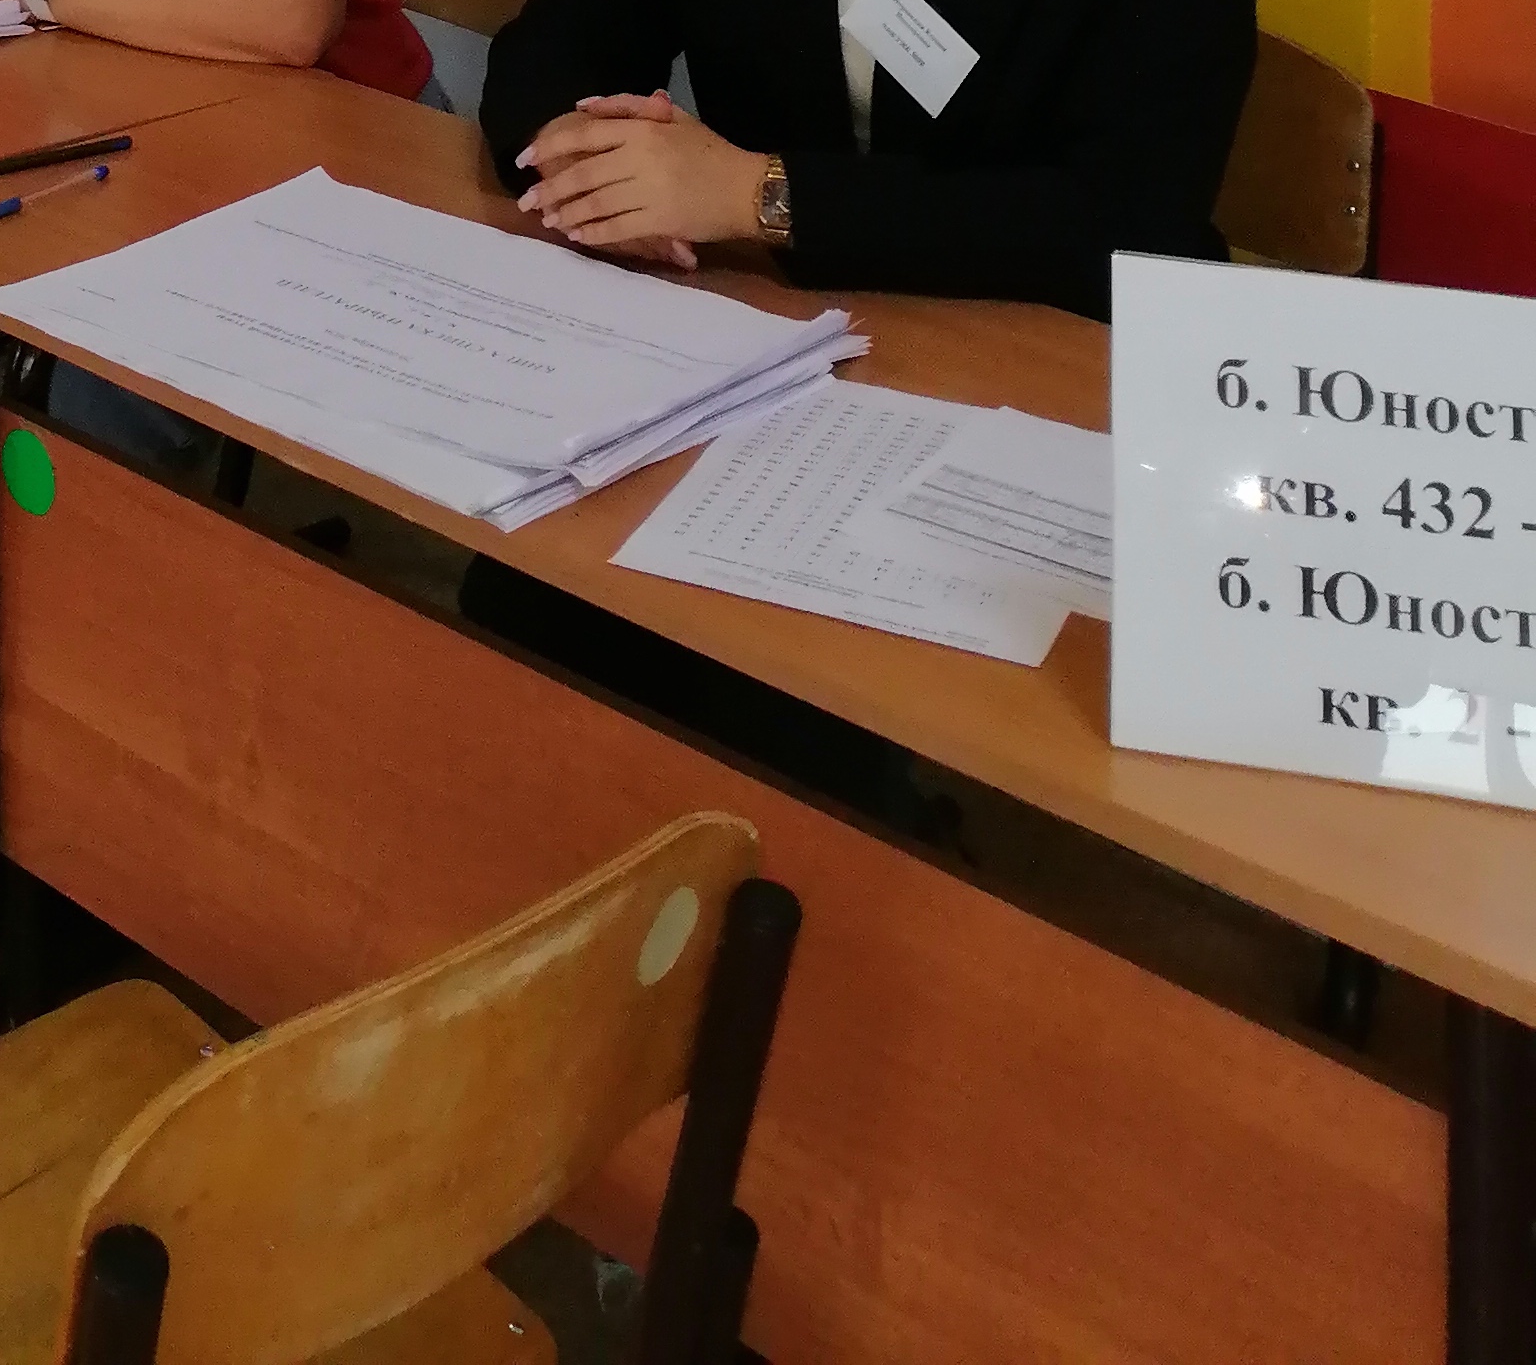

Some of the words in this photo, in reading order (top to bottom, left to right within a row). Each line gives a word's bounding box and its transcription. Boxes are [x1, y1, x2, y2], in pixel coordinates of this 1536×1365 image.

[1216, 357, 1270, 413] б.
[1257, 474, 1358, 524] кв.
[1381, 477, 1496, 541] 432
[1217, 556, 1272, 614] б.
